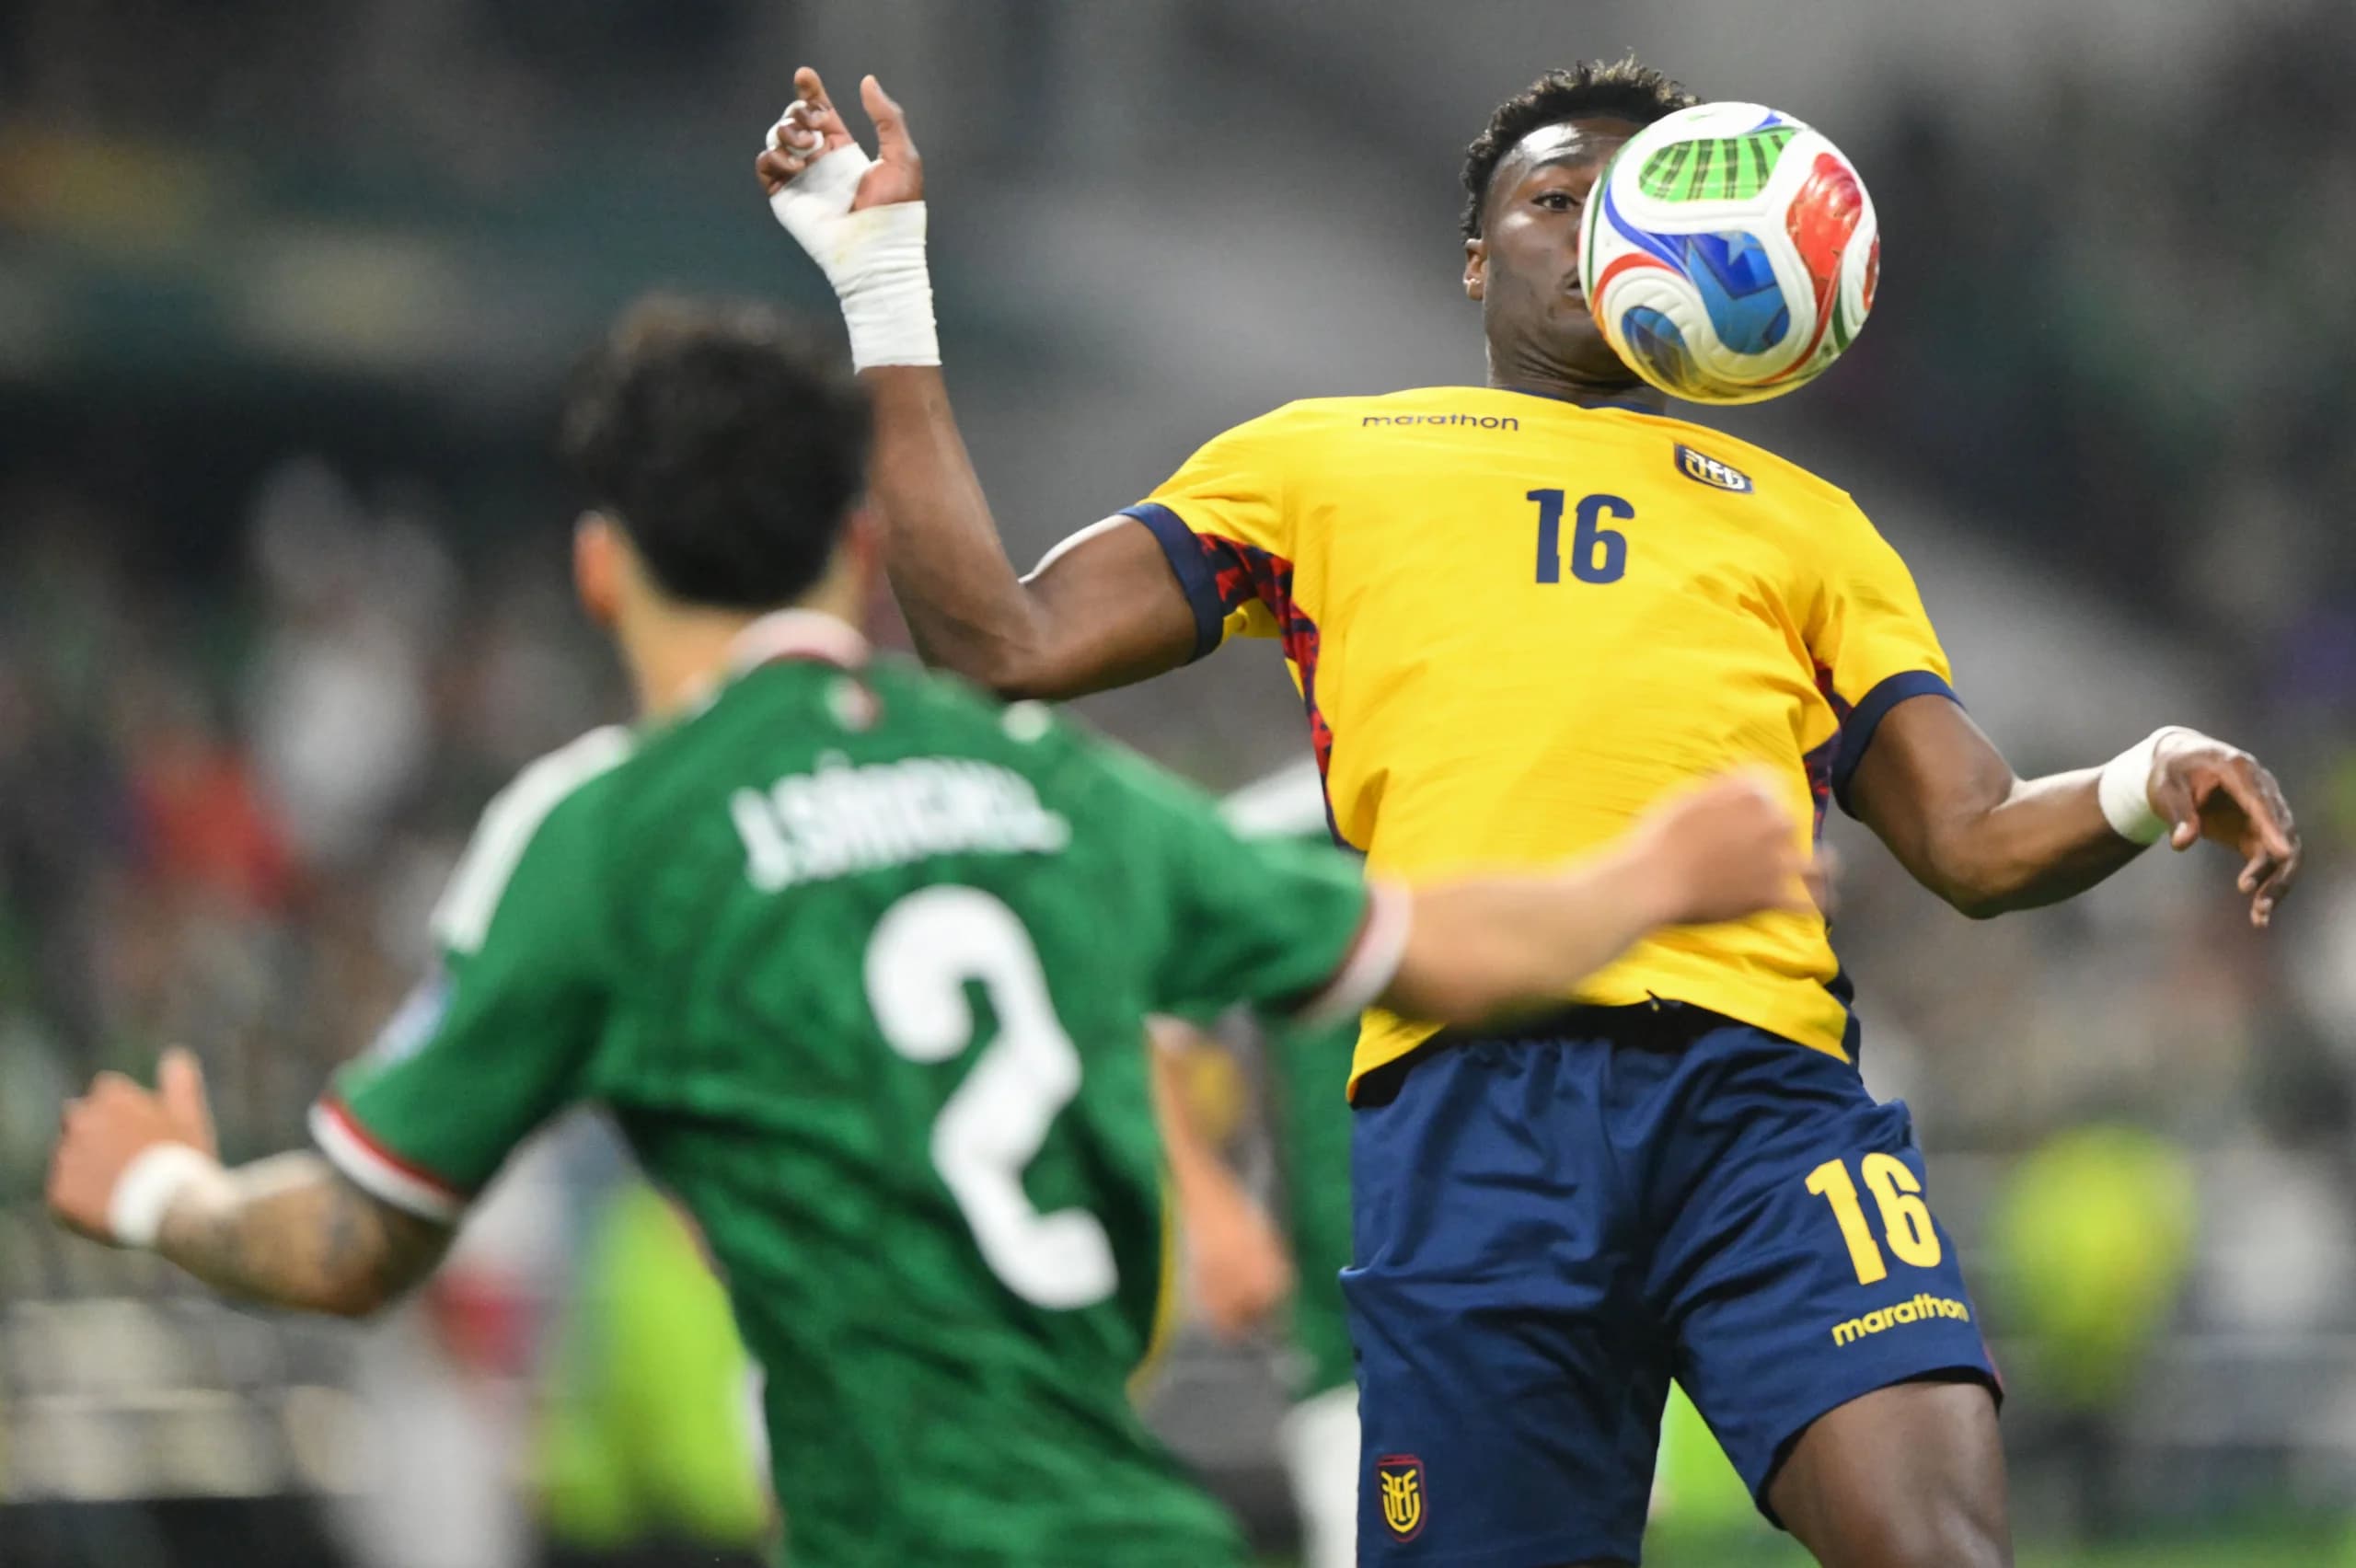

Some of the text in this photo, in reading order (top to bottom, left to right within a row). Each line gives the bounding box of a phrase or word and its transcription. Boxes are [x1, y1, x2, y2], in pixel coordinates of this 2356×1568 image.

[1362, 413, 1519, 432] marathon
[1526, 488, 1636, 584] 16
[864, 885, 1116, 1309] 2
[1805, 1152, 1942, 1286] 16
[1831, 1293, 1969, 1347] marathon
